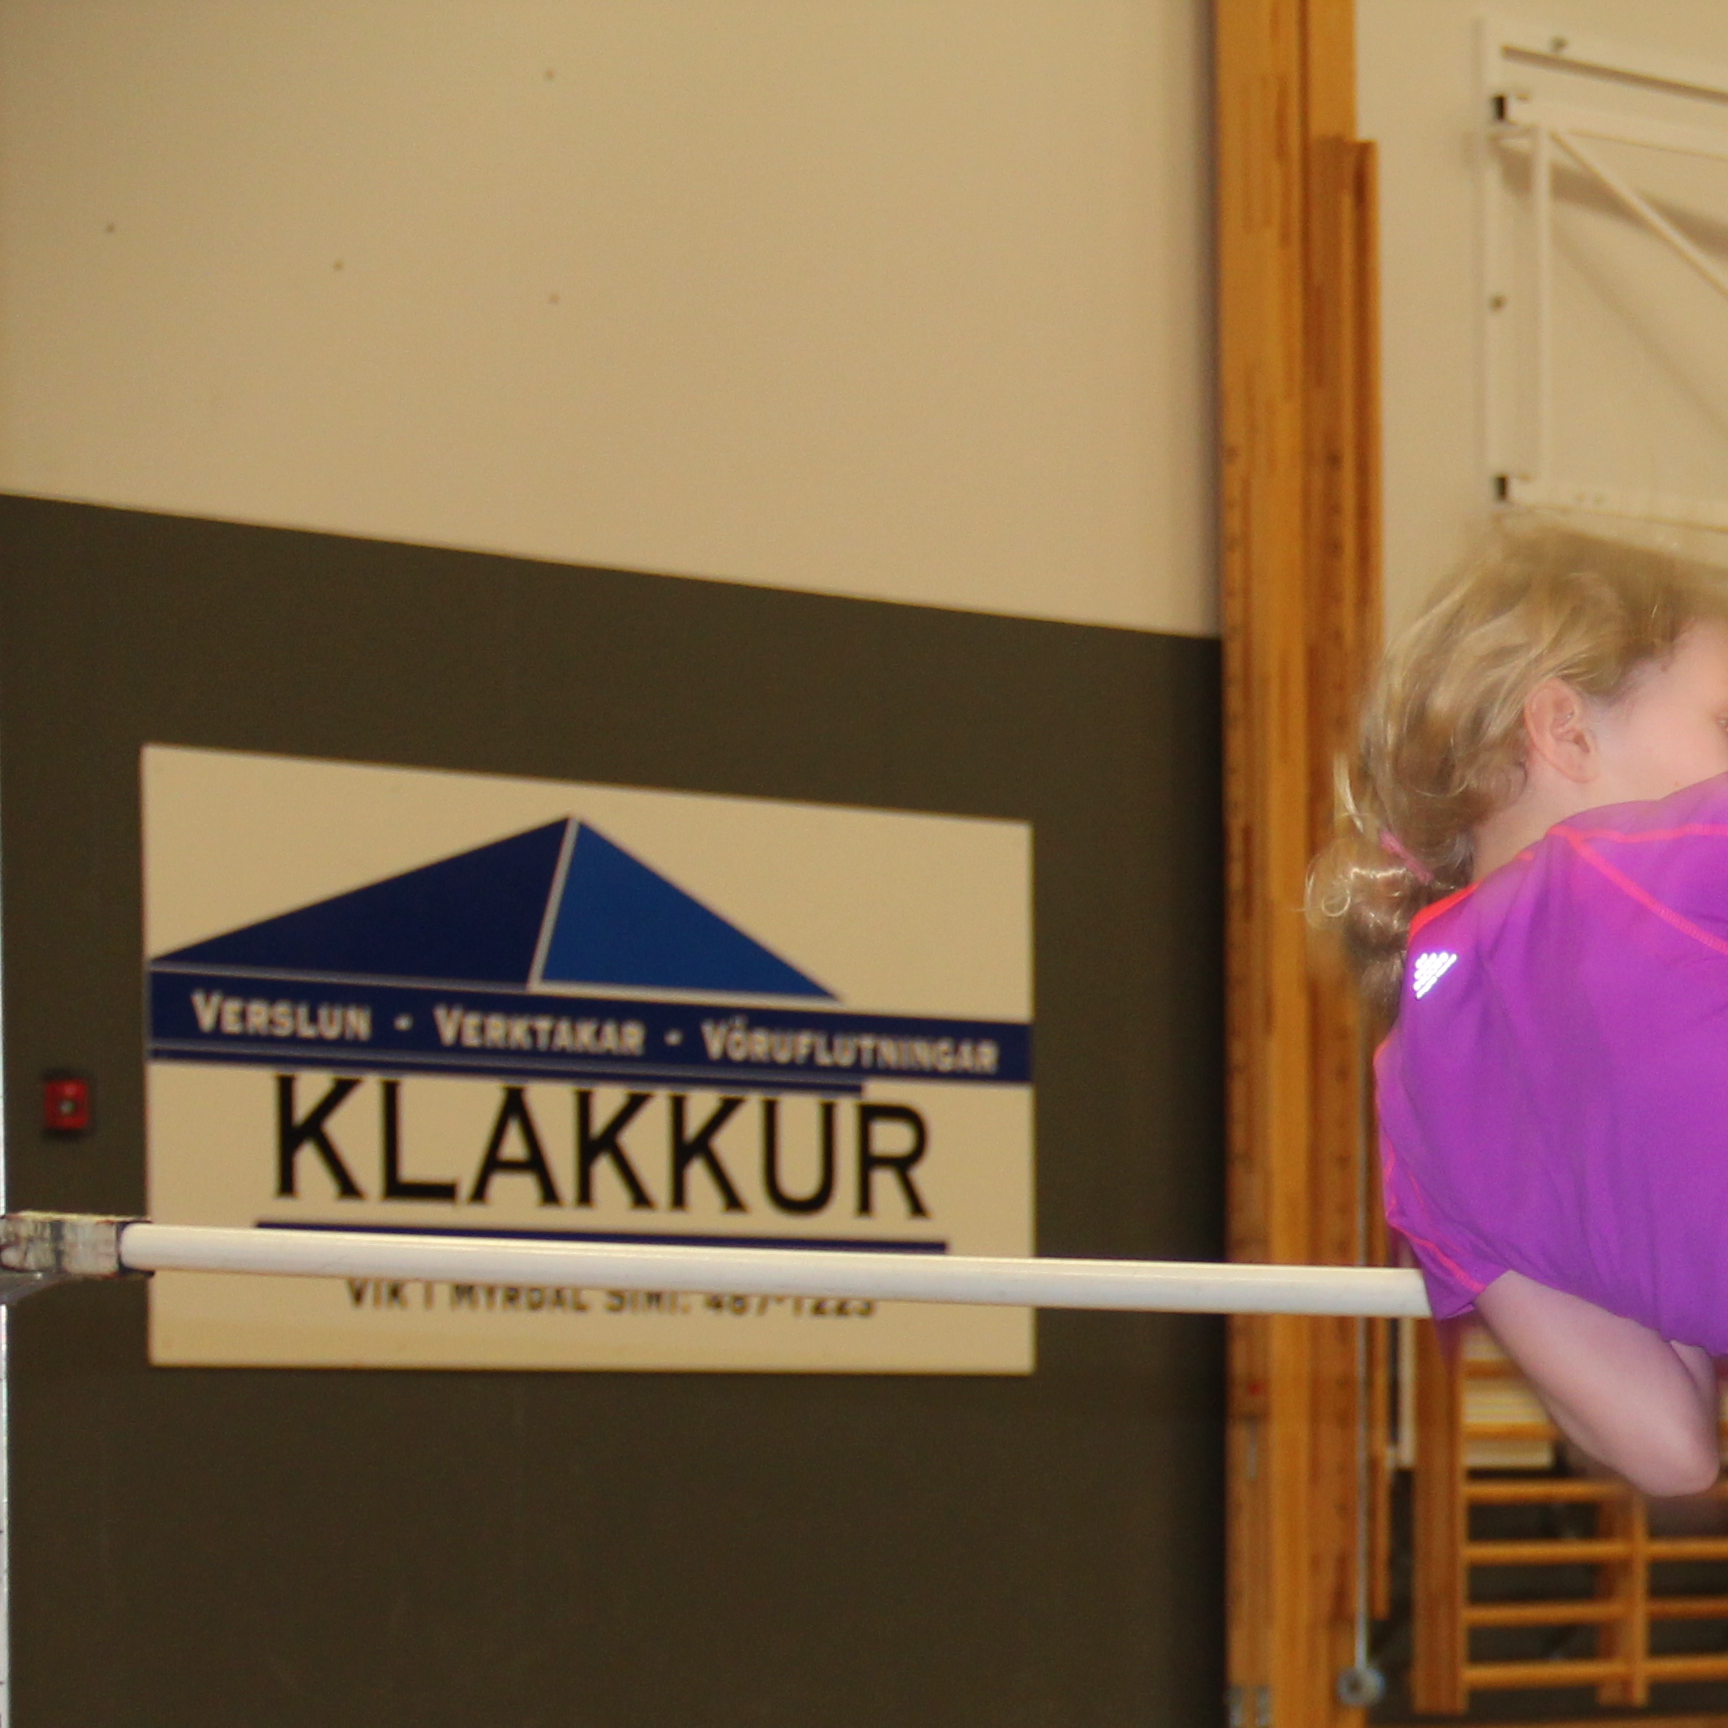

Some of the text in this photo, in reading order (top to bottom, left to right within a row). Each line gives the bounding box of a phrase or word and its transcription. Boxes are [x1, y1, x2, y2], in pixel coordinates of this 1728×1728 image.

[190, 988, 372, 1042] VERSLUN
[432, 1003, 646, 1056] VERKTAKAR
[272, 1073, 931, 1218] KLAKKUR
